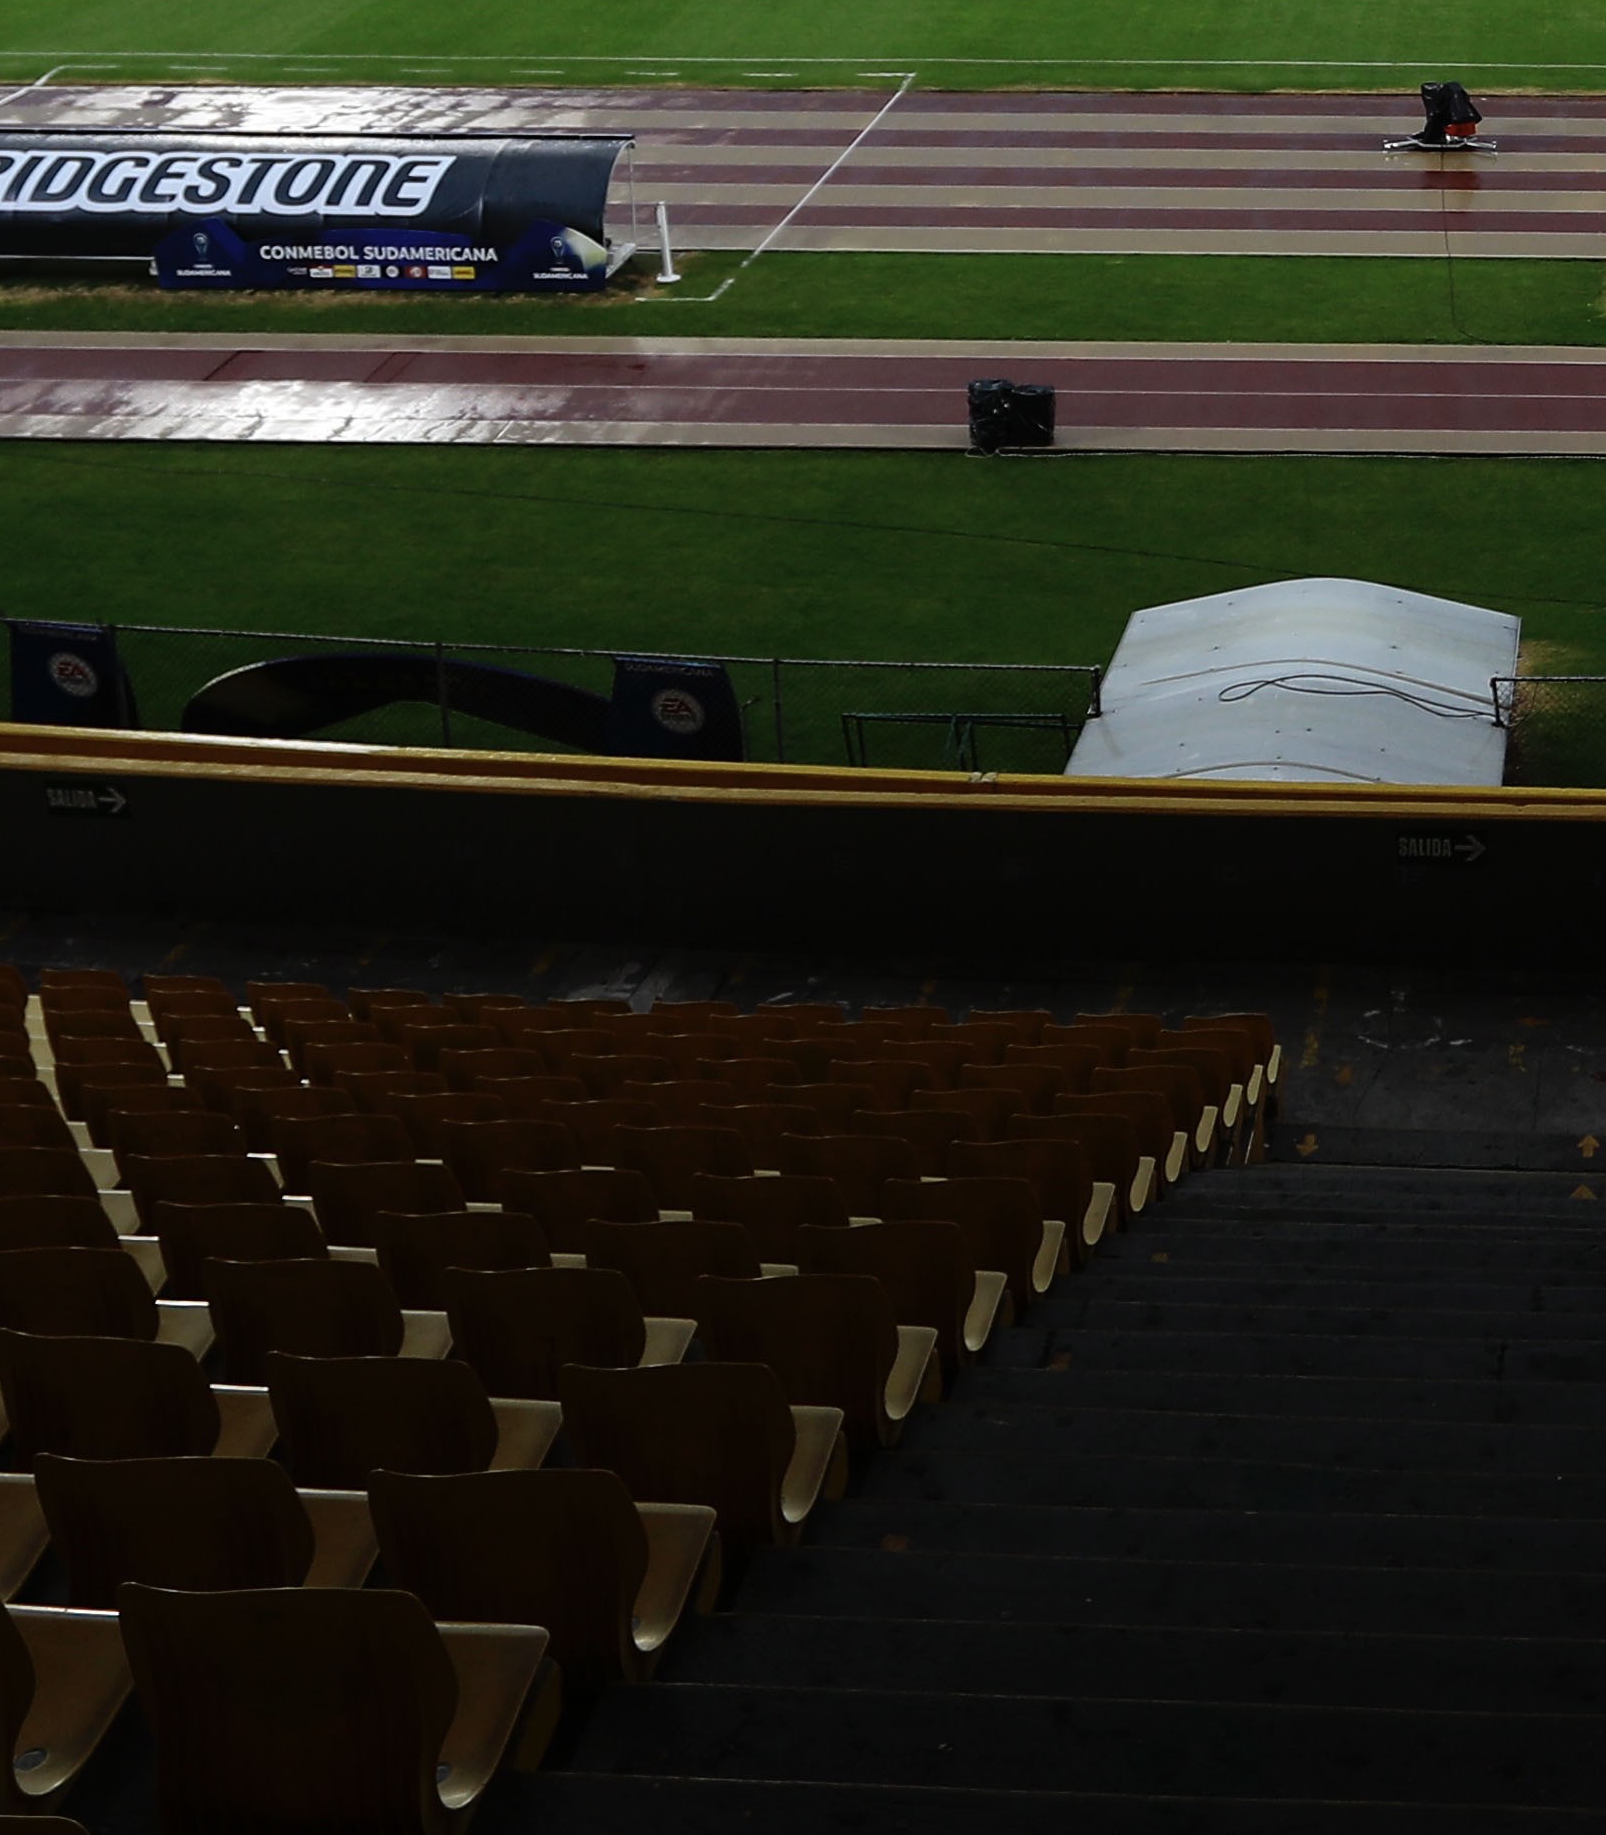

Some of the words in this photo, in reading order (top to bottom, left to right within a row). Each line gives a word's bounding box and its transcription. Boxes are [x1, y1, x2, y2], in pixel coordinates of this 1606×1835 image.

[259, 244, 359, 262] CONMEBOL
[361, 245, 498, 263] SUDAMERICANA
[58, 662, 89, 679] EA
[661, 698, 692, 714] EA
[1398, 837, 1452, 857] SALIDA
